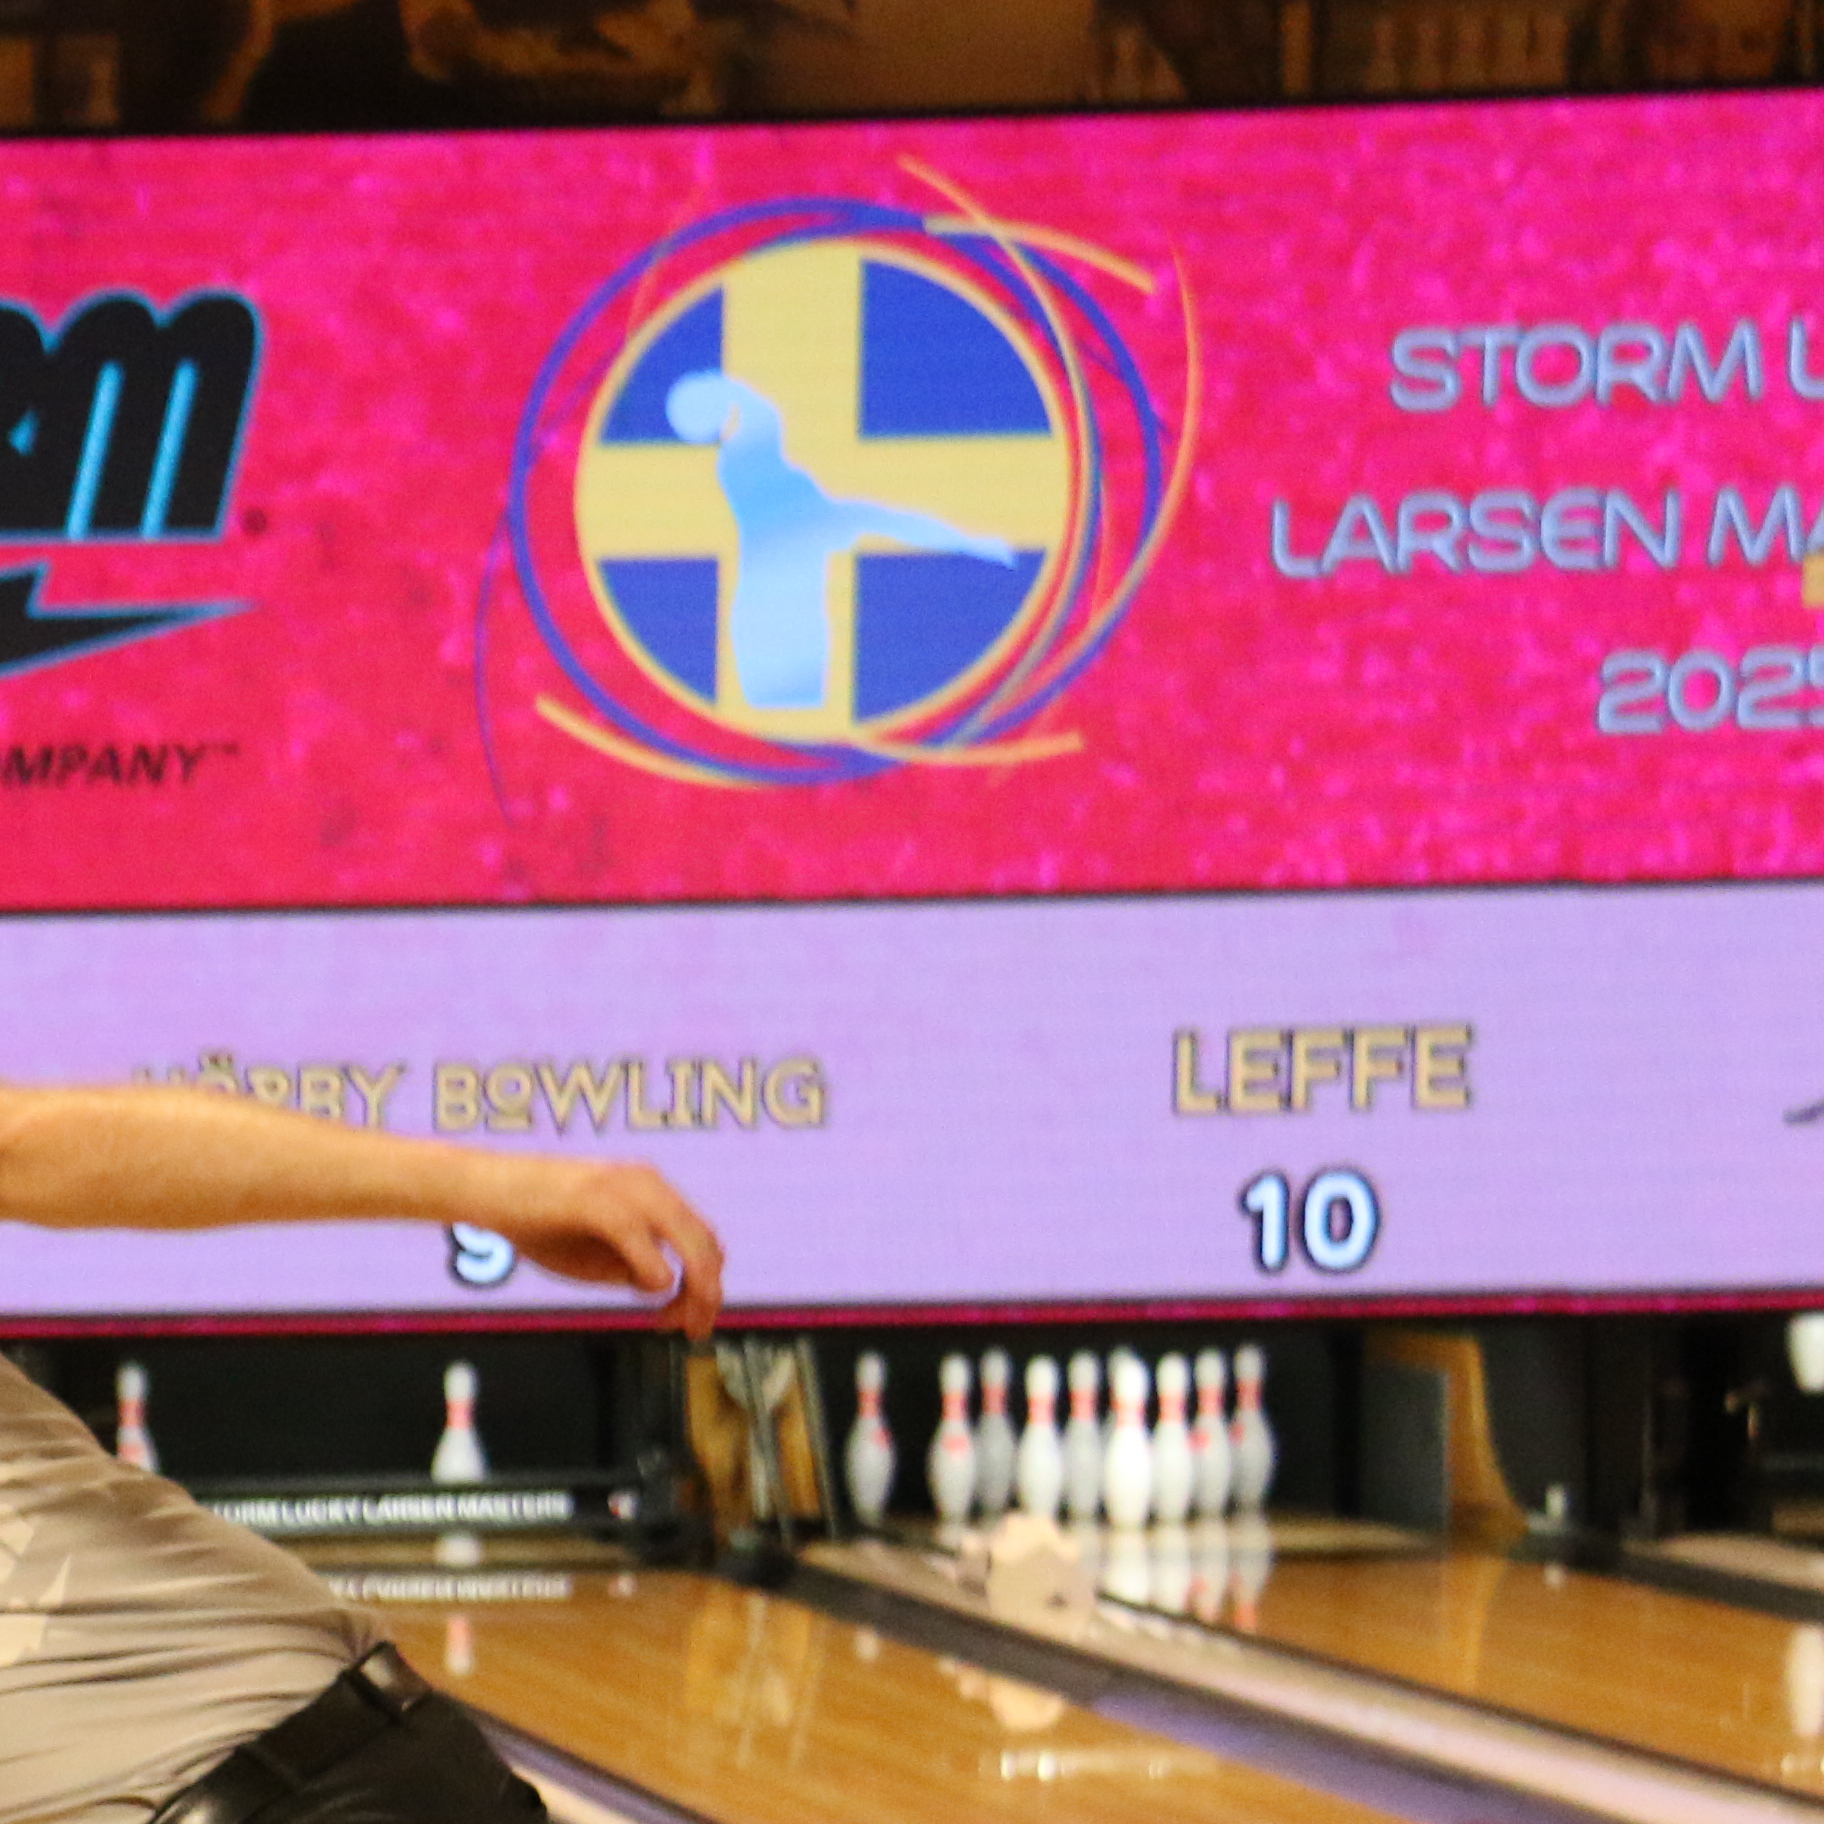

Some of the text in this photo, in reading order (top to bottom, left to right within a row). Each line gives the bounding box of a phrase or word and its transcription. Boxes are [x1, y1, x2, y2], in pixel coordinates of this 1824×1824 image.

[1389, 322, 1763, 412] STORM
[1270, 486, 1682, 579] LARSEN
[433, 1055, 829, 1136] BOWLING
[1172, 1022, 1475, 1117] LEFFE
[1241, 1167, 1381, 1274] 10
